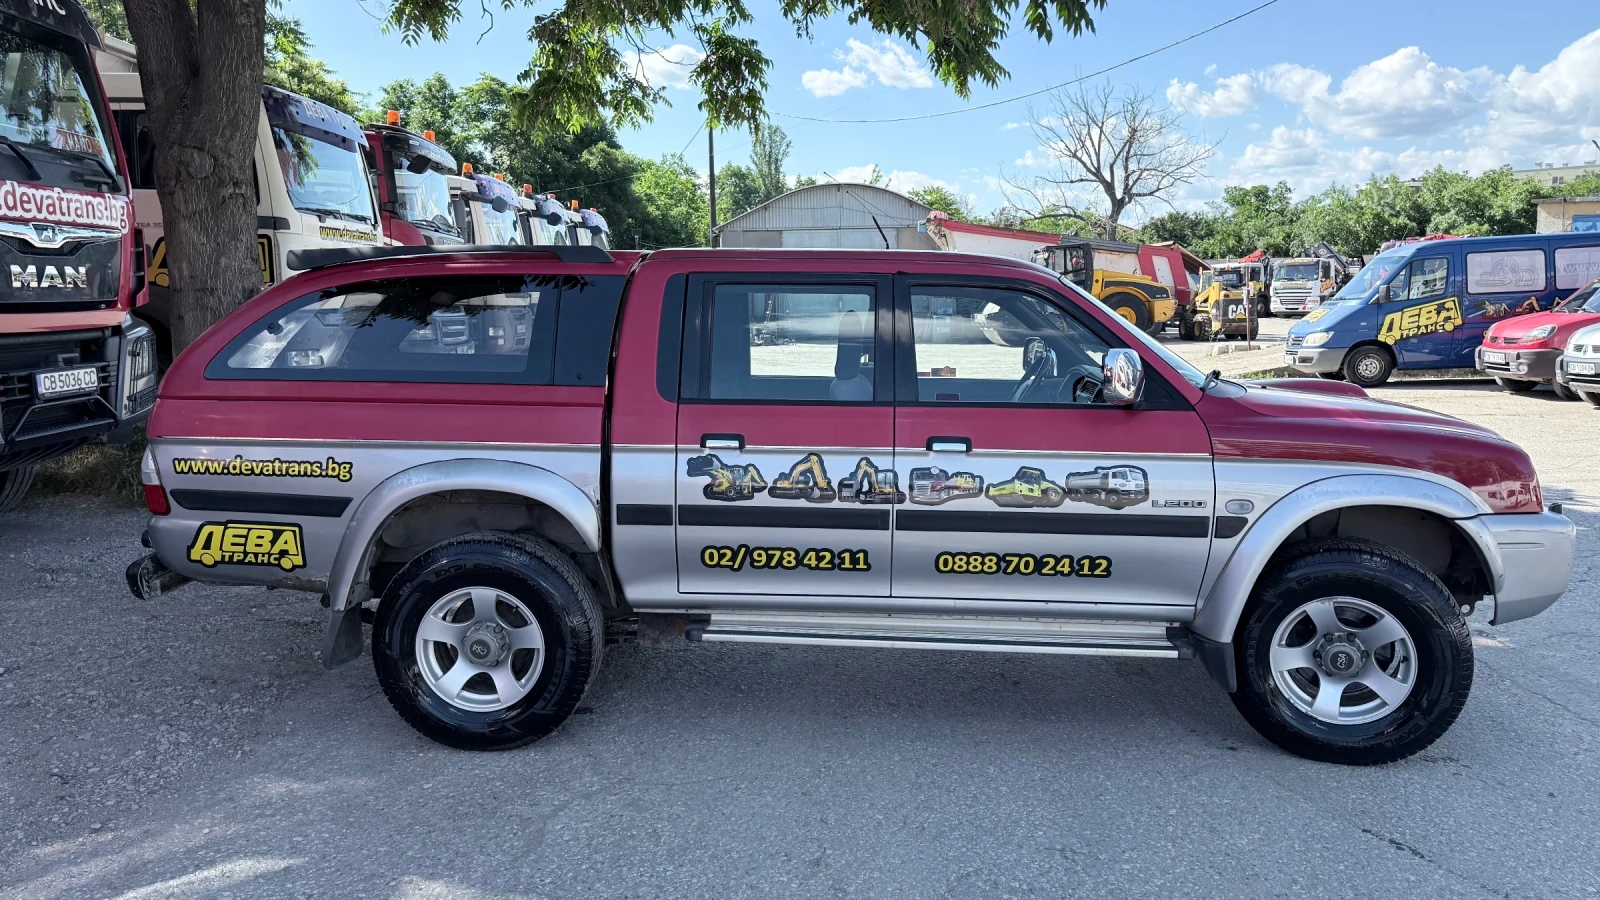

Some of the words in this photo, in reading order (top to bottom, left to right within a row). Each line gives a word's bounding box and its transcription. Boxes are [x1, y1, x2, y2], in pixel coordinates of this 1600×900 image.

[10, 264, 87, 288] MAN
[1378, 299, 1459, 342] ДЕВА
[1401, 322, 1445, 338] ТРАНС
[58, 371, 83, 389] 5036
[173, 457, 352, 481] www.devatrans.bg
[1152, 500, 1207, 508] L200
[191, 524, 300, 560] ДЕВА
[221, 551, 281, 564] ТРАНС
[704, 547, 746, 569] 02/
[752, 549, 797, 567] 978
[803, 551, 832, 568] 42
[840, 552, 868, 569] 11
[938, 554, 998, 573] 0888
[1005, 556, 1035, 573] 70
[1041, 557, 1071, 574] 24
[1079, 559, 1108, 575] 12
